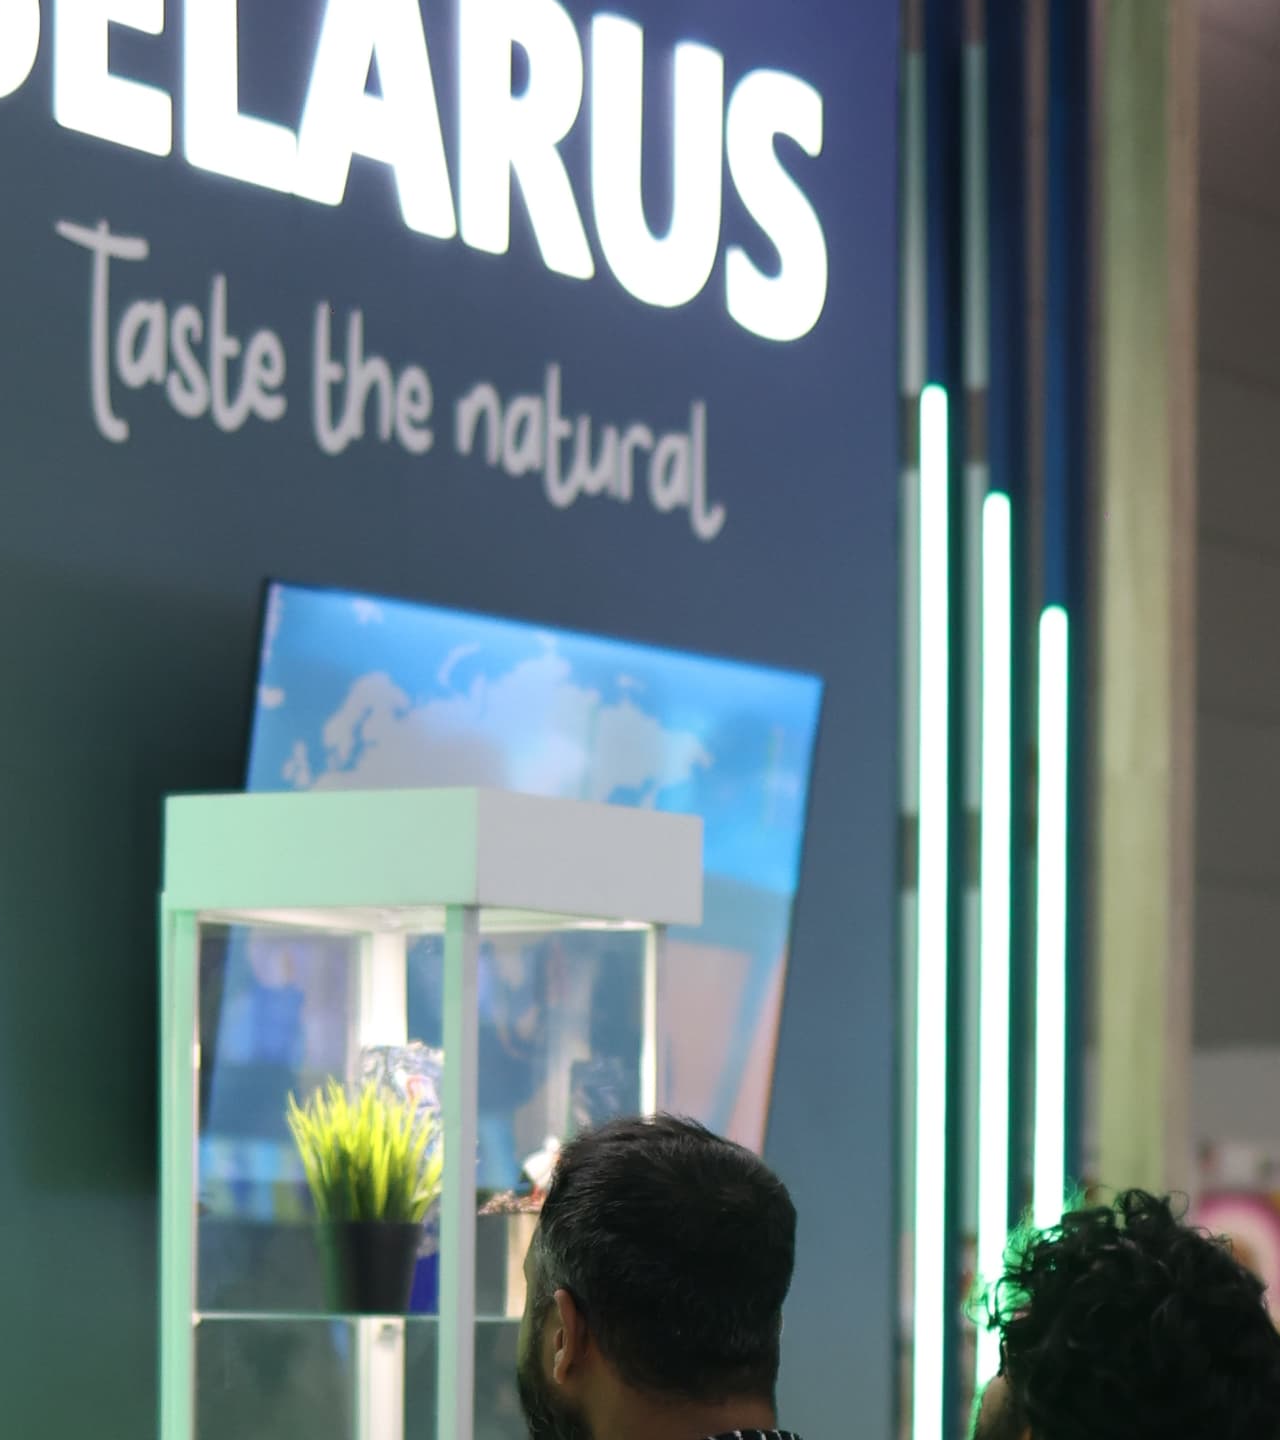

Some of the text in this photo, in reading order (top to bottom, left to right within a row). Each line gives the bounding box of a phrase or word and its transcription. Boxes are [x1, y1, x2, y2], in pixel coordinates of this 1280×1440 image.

[54, 220, 725, 541] Taste the natural
